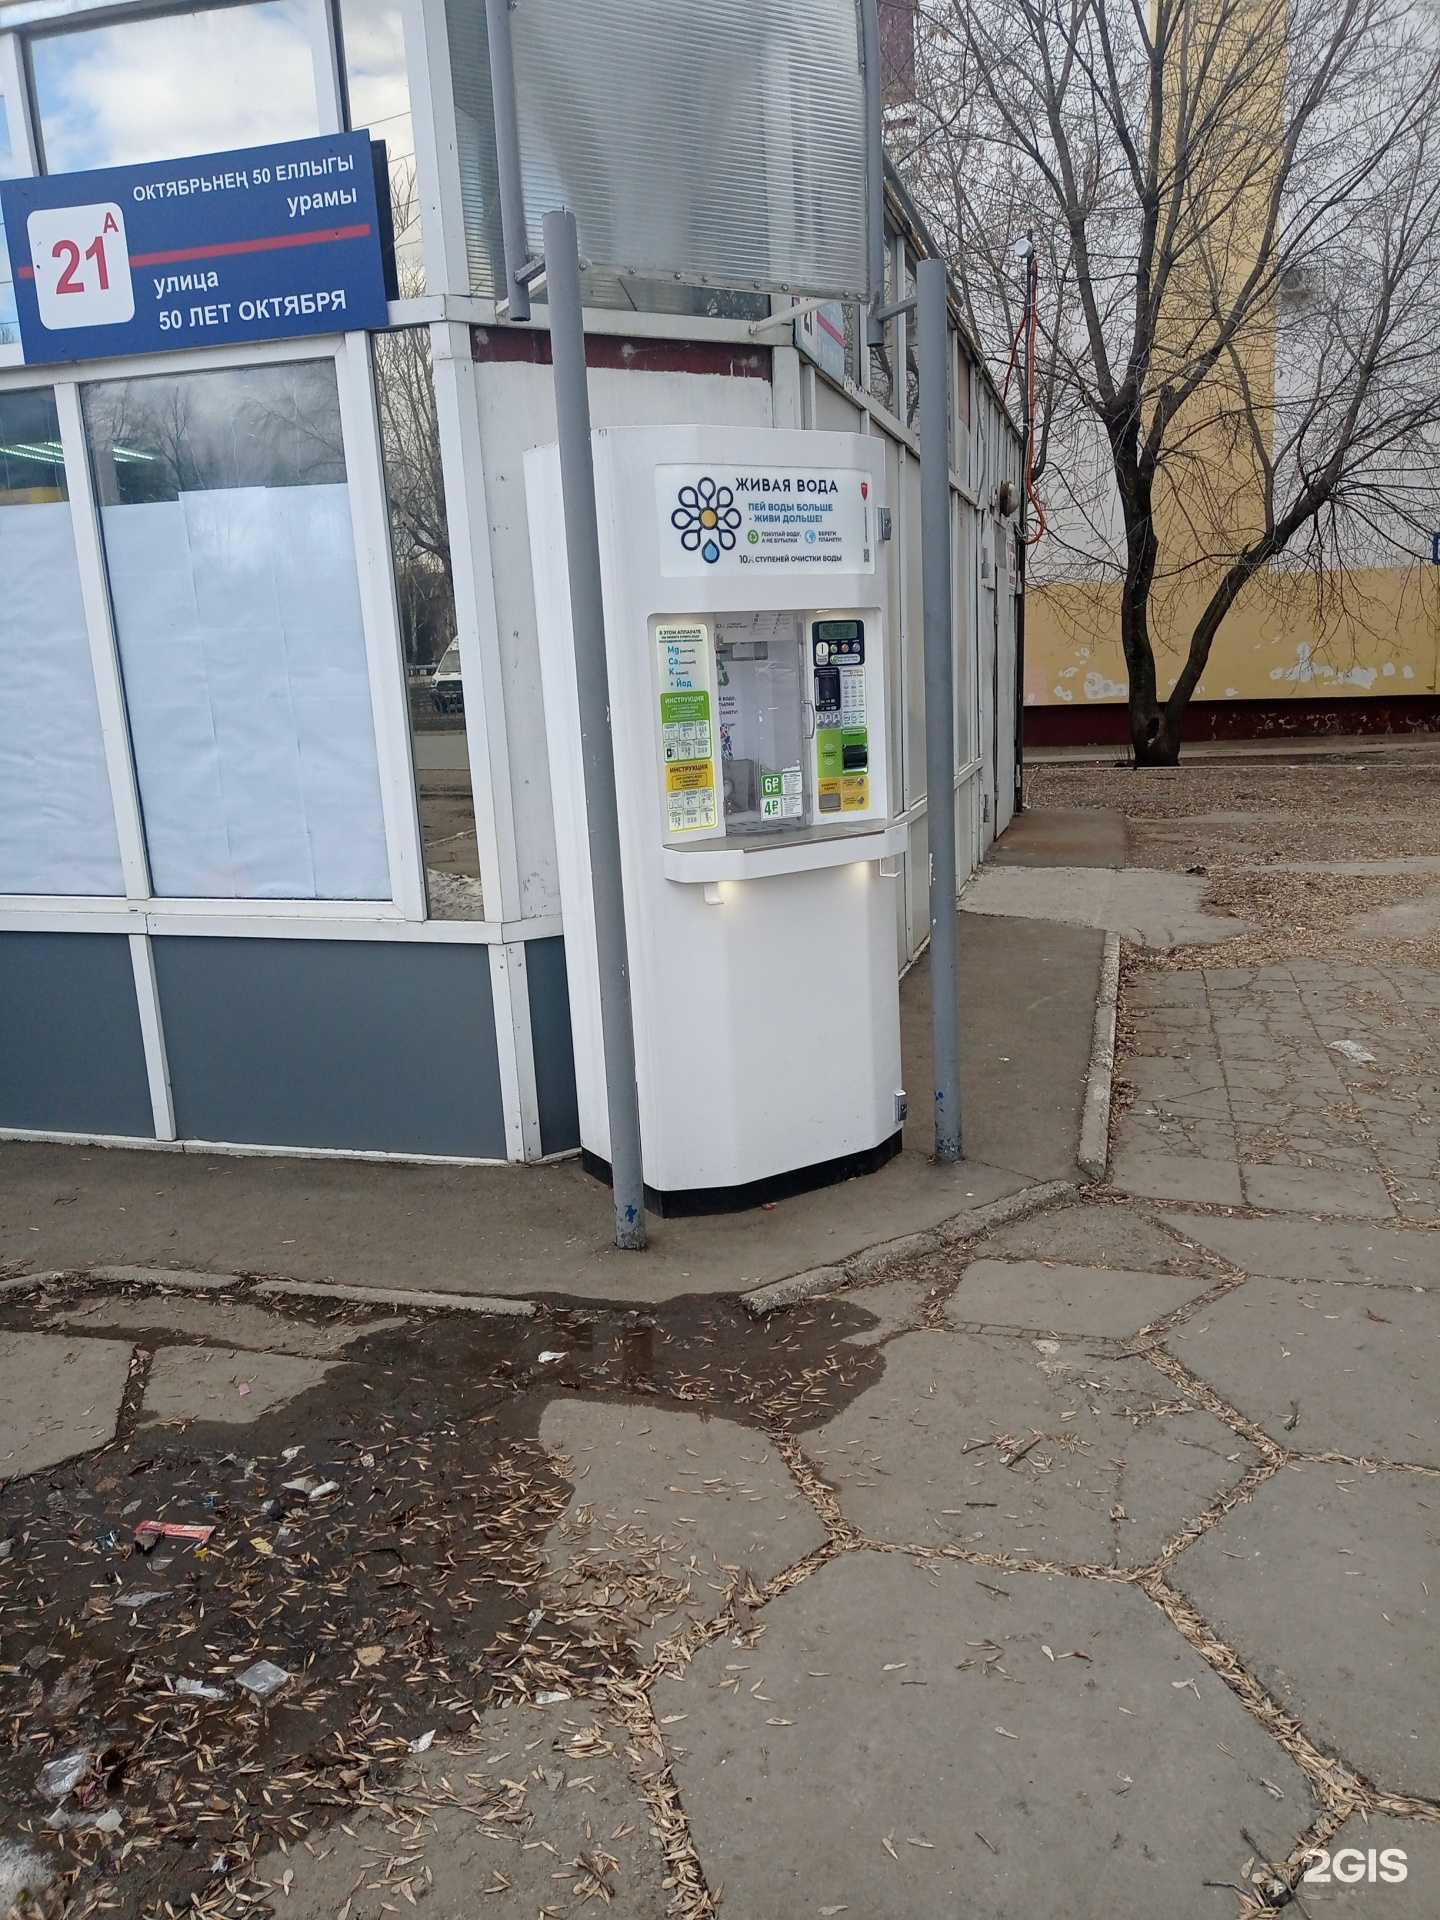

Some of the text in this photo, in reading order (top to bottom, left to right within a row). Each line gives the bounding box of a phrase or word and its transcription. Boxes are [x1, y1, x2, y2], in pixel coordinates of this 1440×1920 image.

[133, 154, 354, 201] ОКТЯБРЬНЕҢ 50 ЕЛЛЫГЫ
[287, 187, 357, 218] урамы
[51, 235, 109, 295] 21
[154, 269, 219, 299] улица
[159, 289, 347, 331] 50 ЛЕТ ОКТЯБРЯ
[735, 477, 839, 495] ЖИВАЯ ВОДА
[748, 501, 833, 513] ПЕЙ ВОДЫ БОЛЬШЕ
[754, 514, 781, 523] ЖИВИ
[782, 514, 823, 524] ДОЛЬШЕ!
[755, 555, 790, 563] СТУПЕНЕЙ
